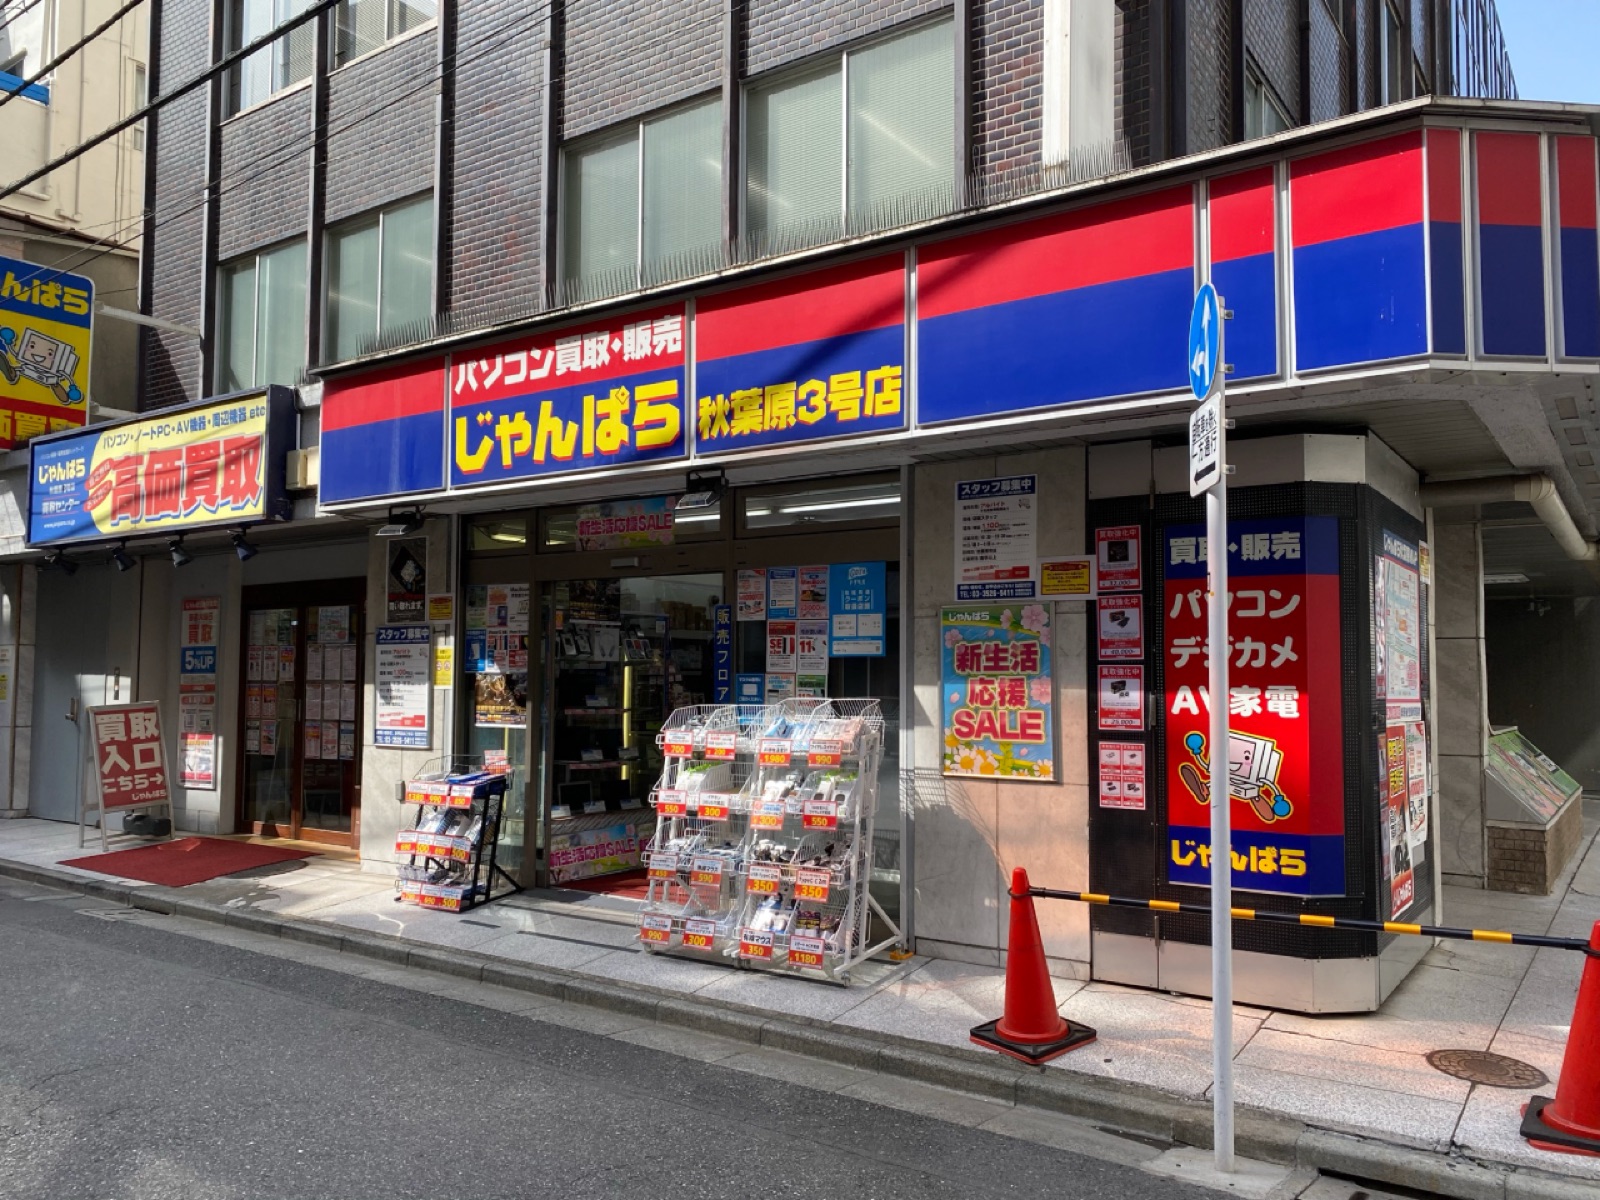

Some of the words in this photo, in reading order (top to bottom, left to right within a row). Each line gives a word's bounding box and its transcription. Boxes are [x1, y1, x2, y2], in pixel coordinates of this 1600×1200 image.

[455, 316, 682, 394] パソコン買取・販売
[698, 365, 903, 441] 秋葉原3号店
[455, 378, 681, 475] じゃんぱら
[110, 434, 263, 525] 高価買取
[961, 479, 1032, 495] スタッフ募集中
[578, 513, 673, 536] 新生活応援SALE
[949, 612, 990, 622] じゃんぱら
[188, 623, 212, 643] 買取
[379, 629, 429, 640] スタッフ募集中
[716, 608, 730, 700] 販売フロア
[955, 641, 1039, 674] 新生活
[967, 676, 1028, 708] 応援
[96, 711, 159, 744] 買取
[953, 709, 1045, 743] SALE
[101, 741, 161, 774] 入口
[102, 773, 150, 793] こちら
[132, 789, 167, 800] じゃんぱら
[704, 807, 720, 816] 300
[811, 817, 828, 826] 550
[753, 879, 774, 891] 350
[801, 885, 822, 898] 350
[688, 935, 706, 946] 300
[748, 945, 764, 955] 350
